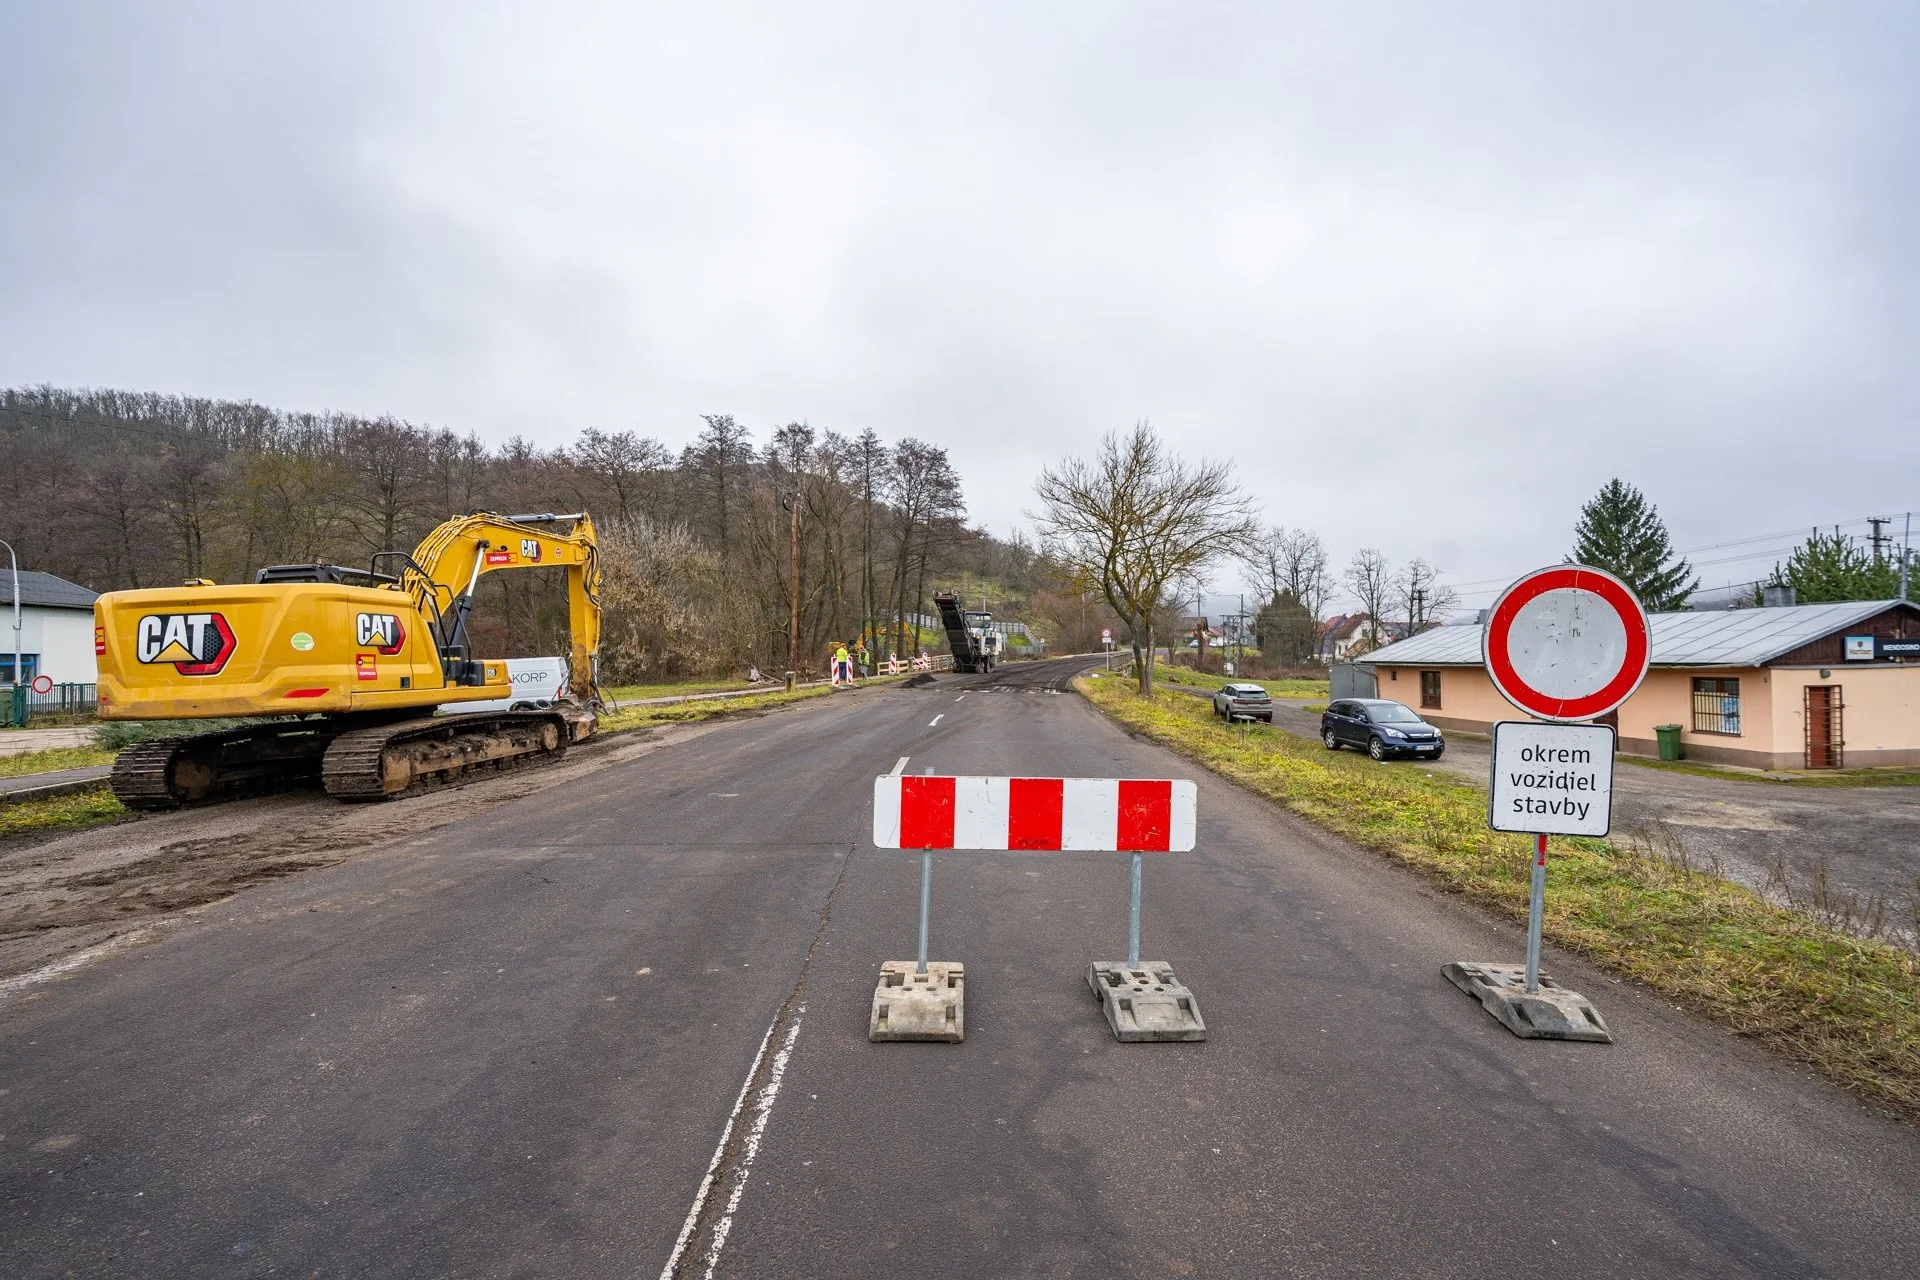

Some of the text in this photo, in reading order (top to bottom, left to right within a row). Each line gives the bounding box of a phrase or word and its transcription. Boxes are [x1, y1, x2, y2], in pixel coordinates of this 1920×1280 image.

[521, 540, 538, 558] CAT
[138, 614, 212, 663] CAT
[357, 613, 394, 646] CAT
[1521, 744, 1590, 764] okrem
[1510, 770, 1596, 792] vozidiel
[1512, 796, 1590, 821] stavby
